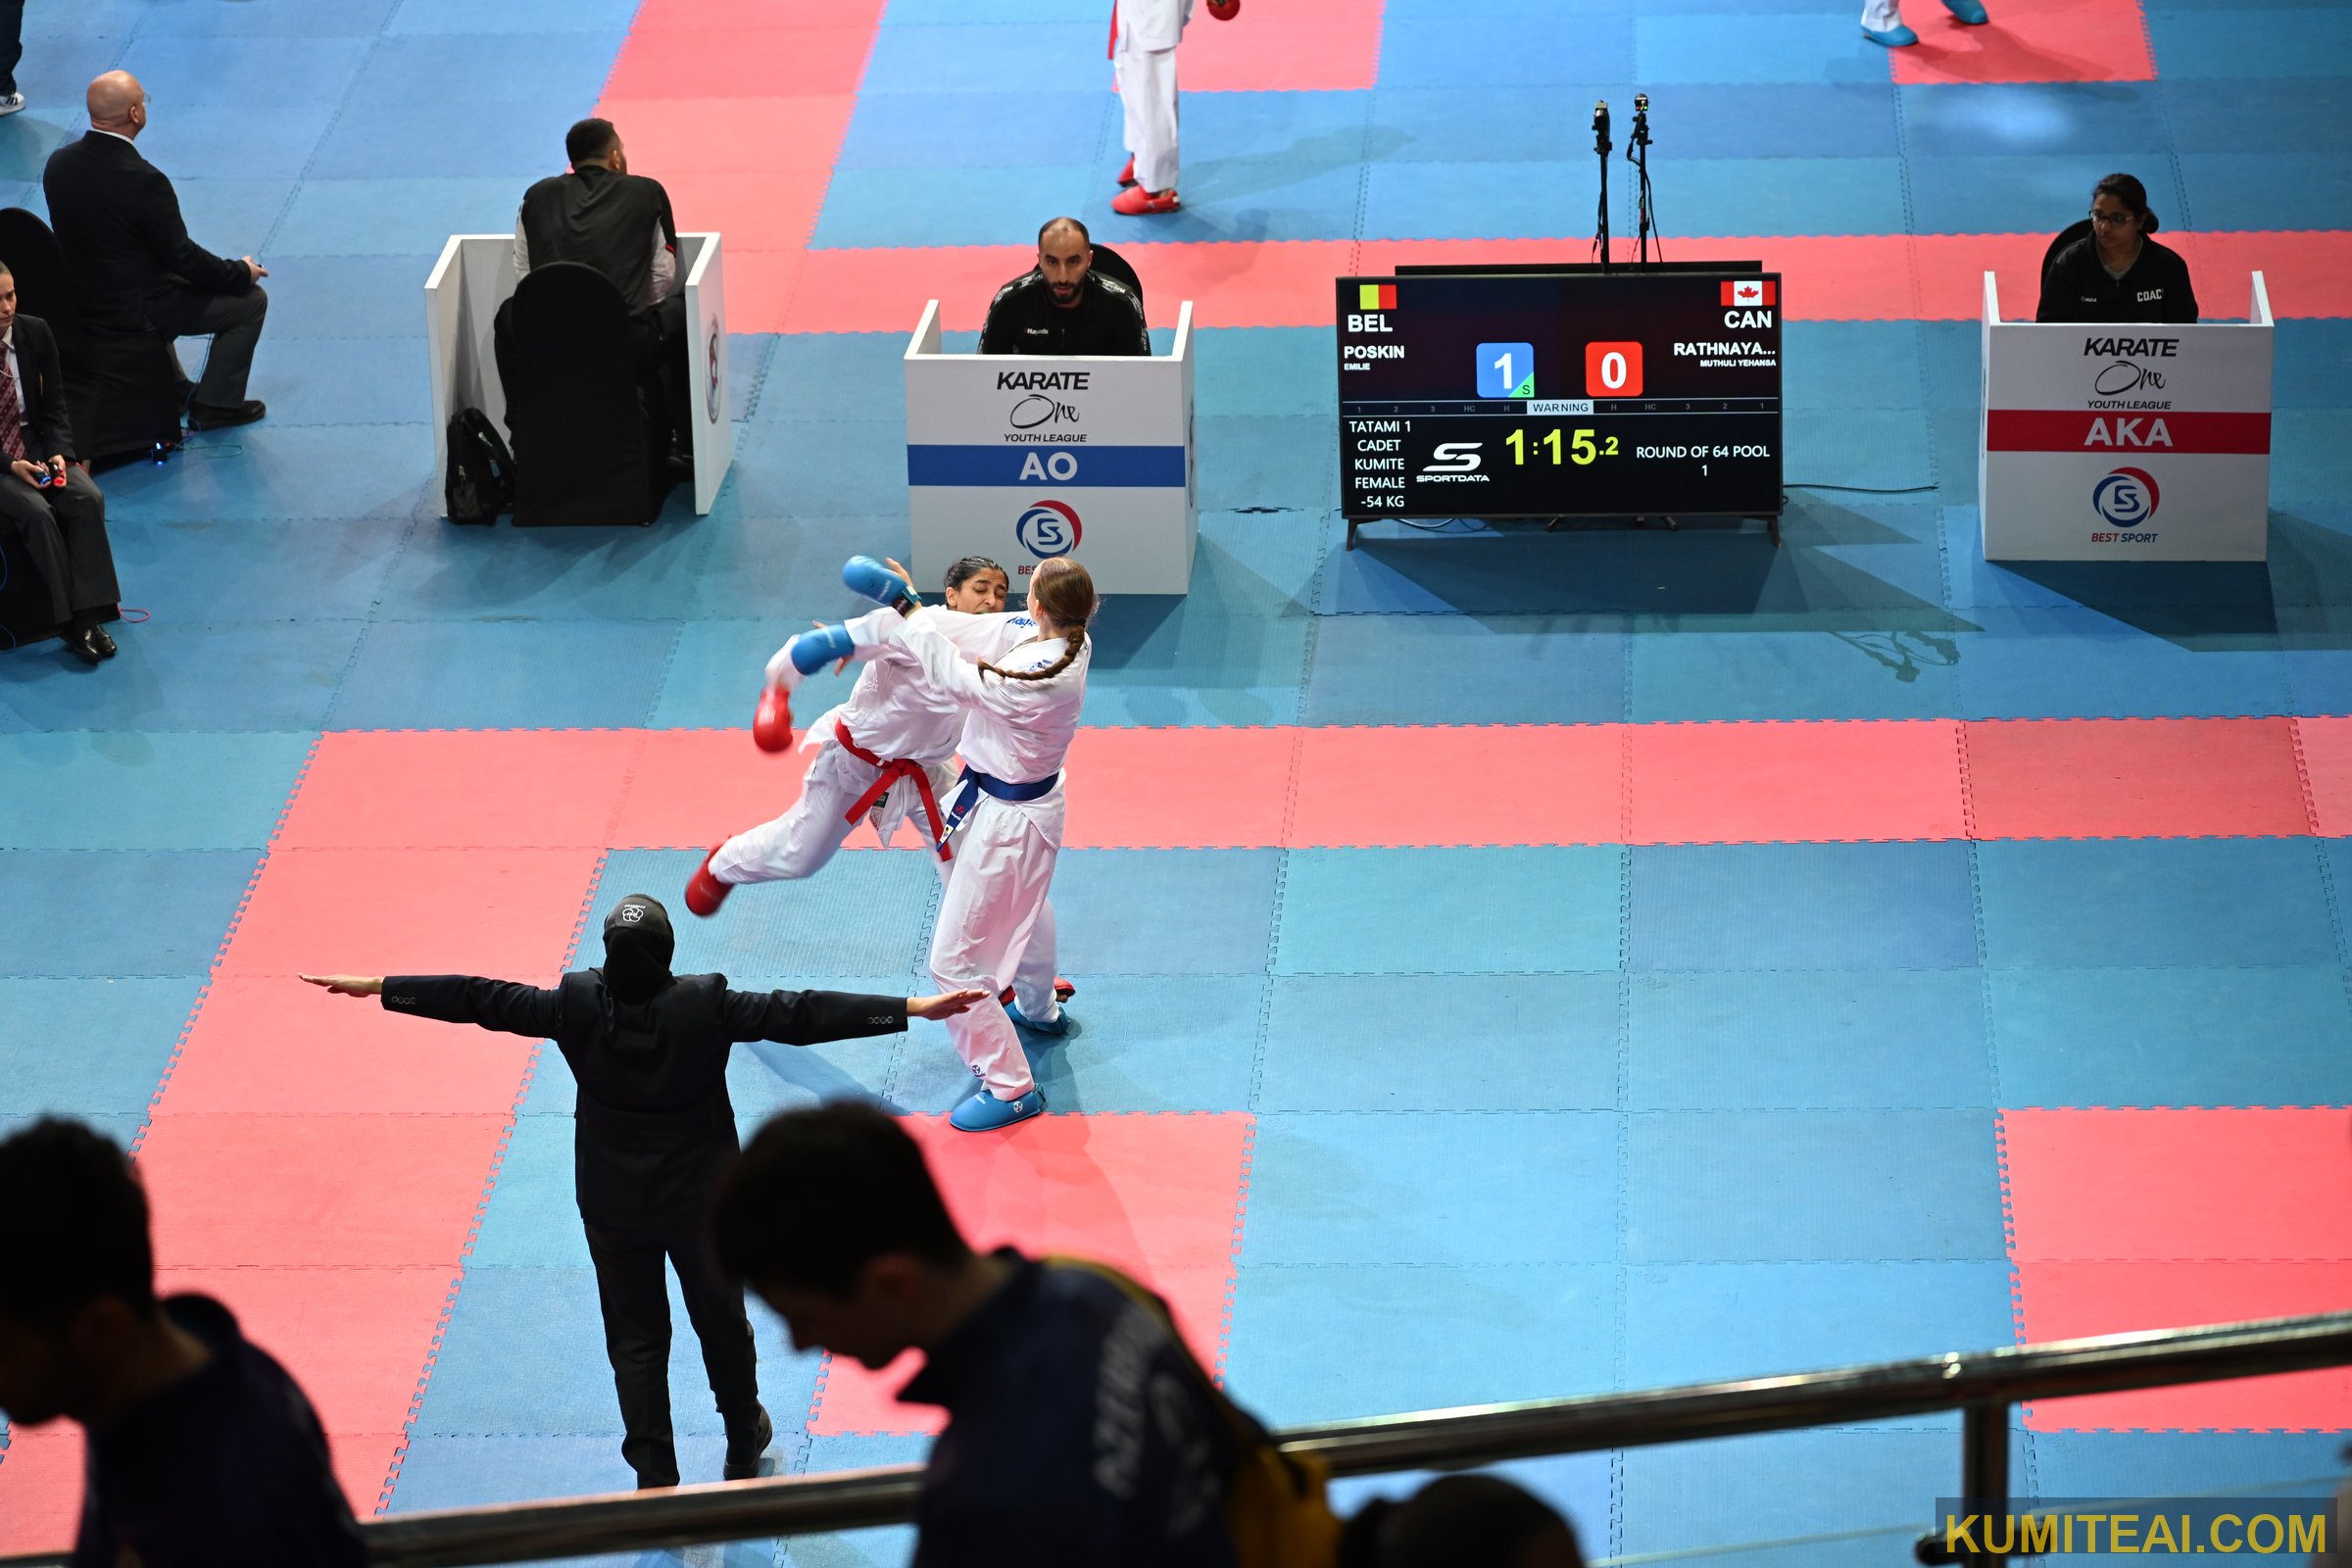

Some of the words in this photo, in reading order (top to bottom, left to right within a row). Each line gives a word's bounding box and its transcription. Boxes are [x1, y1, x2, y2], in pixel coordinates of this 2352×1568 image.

[2136, 288, 2164, 302] COAC
[1348, 314, 1393, 332] BEL
[1724, 311, 1772, 328] CAN
[1344, 345, 1404, 359] POSKIN
[1673, 342, 1776, 356] RATHNAYA...
[2083, 337, 2180, 357] KARATE
[1601, 351, 1627, 389] 0
[1699, 359, 1737, 368] MUTHULI
[1494, 353, 1512, 390] 1
[2094, 360, 2166, 396] One
[997, 371, 1090, 390] KARATE
[1522, 384, 1531, 395] S
[1009, 394, 1080, 429] One
[1533, 403, 1589, 413] WARNING
[2087, 400, 2126, 409] YOUTH
[2127, 400, 2172, 410] LEAGUE
[1348, 420, 1400, 432] TATAMI
[1404, 420, 1411, 432] 1
[2083, 416, 2174, 447] AKA
[1004, 433, 1042, 443] YOUTH
[1043, 433, 1087, 443] LEAGUE
[1356, 439, 1401, 452] CADET
[1636, 446, 1687, 458] ROUND
[1690, 445, 1709, 458] OF
[1712, 445, 1729, 458] 64
[1733, 445, 1771, 458] POOL
[1019, 451, 1078, 481] AO
[1354, 458, 1404, 470] KUMITE
[1701, 465, 1708, 476] 1
[1354, 477, 1405, 489] FEMALE
[1360, 496, 1383, 508] -54
[1386, 495, 1404, 508] KG
[2091, 532, 2119, 543] BEST
[2121, 533, 2158, 543] SPORT
[1017, 564, 1038, 575] BES
